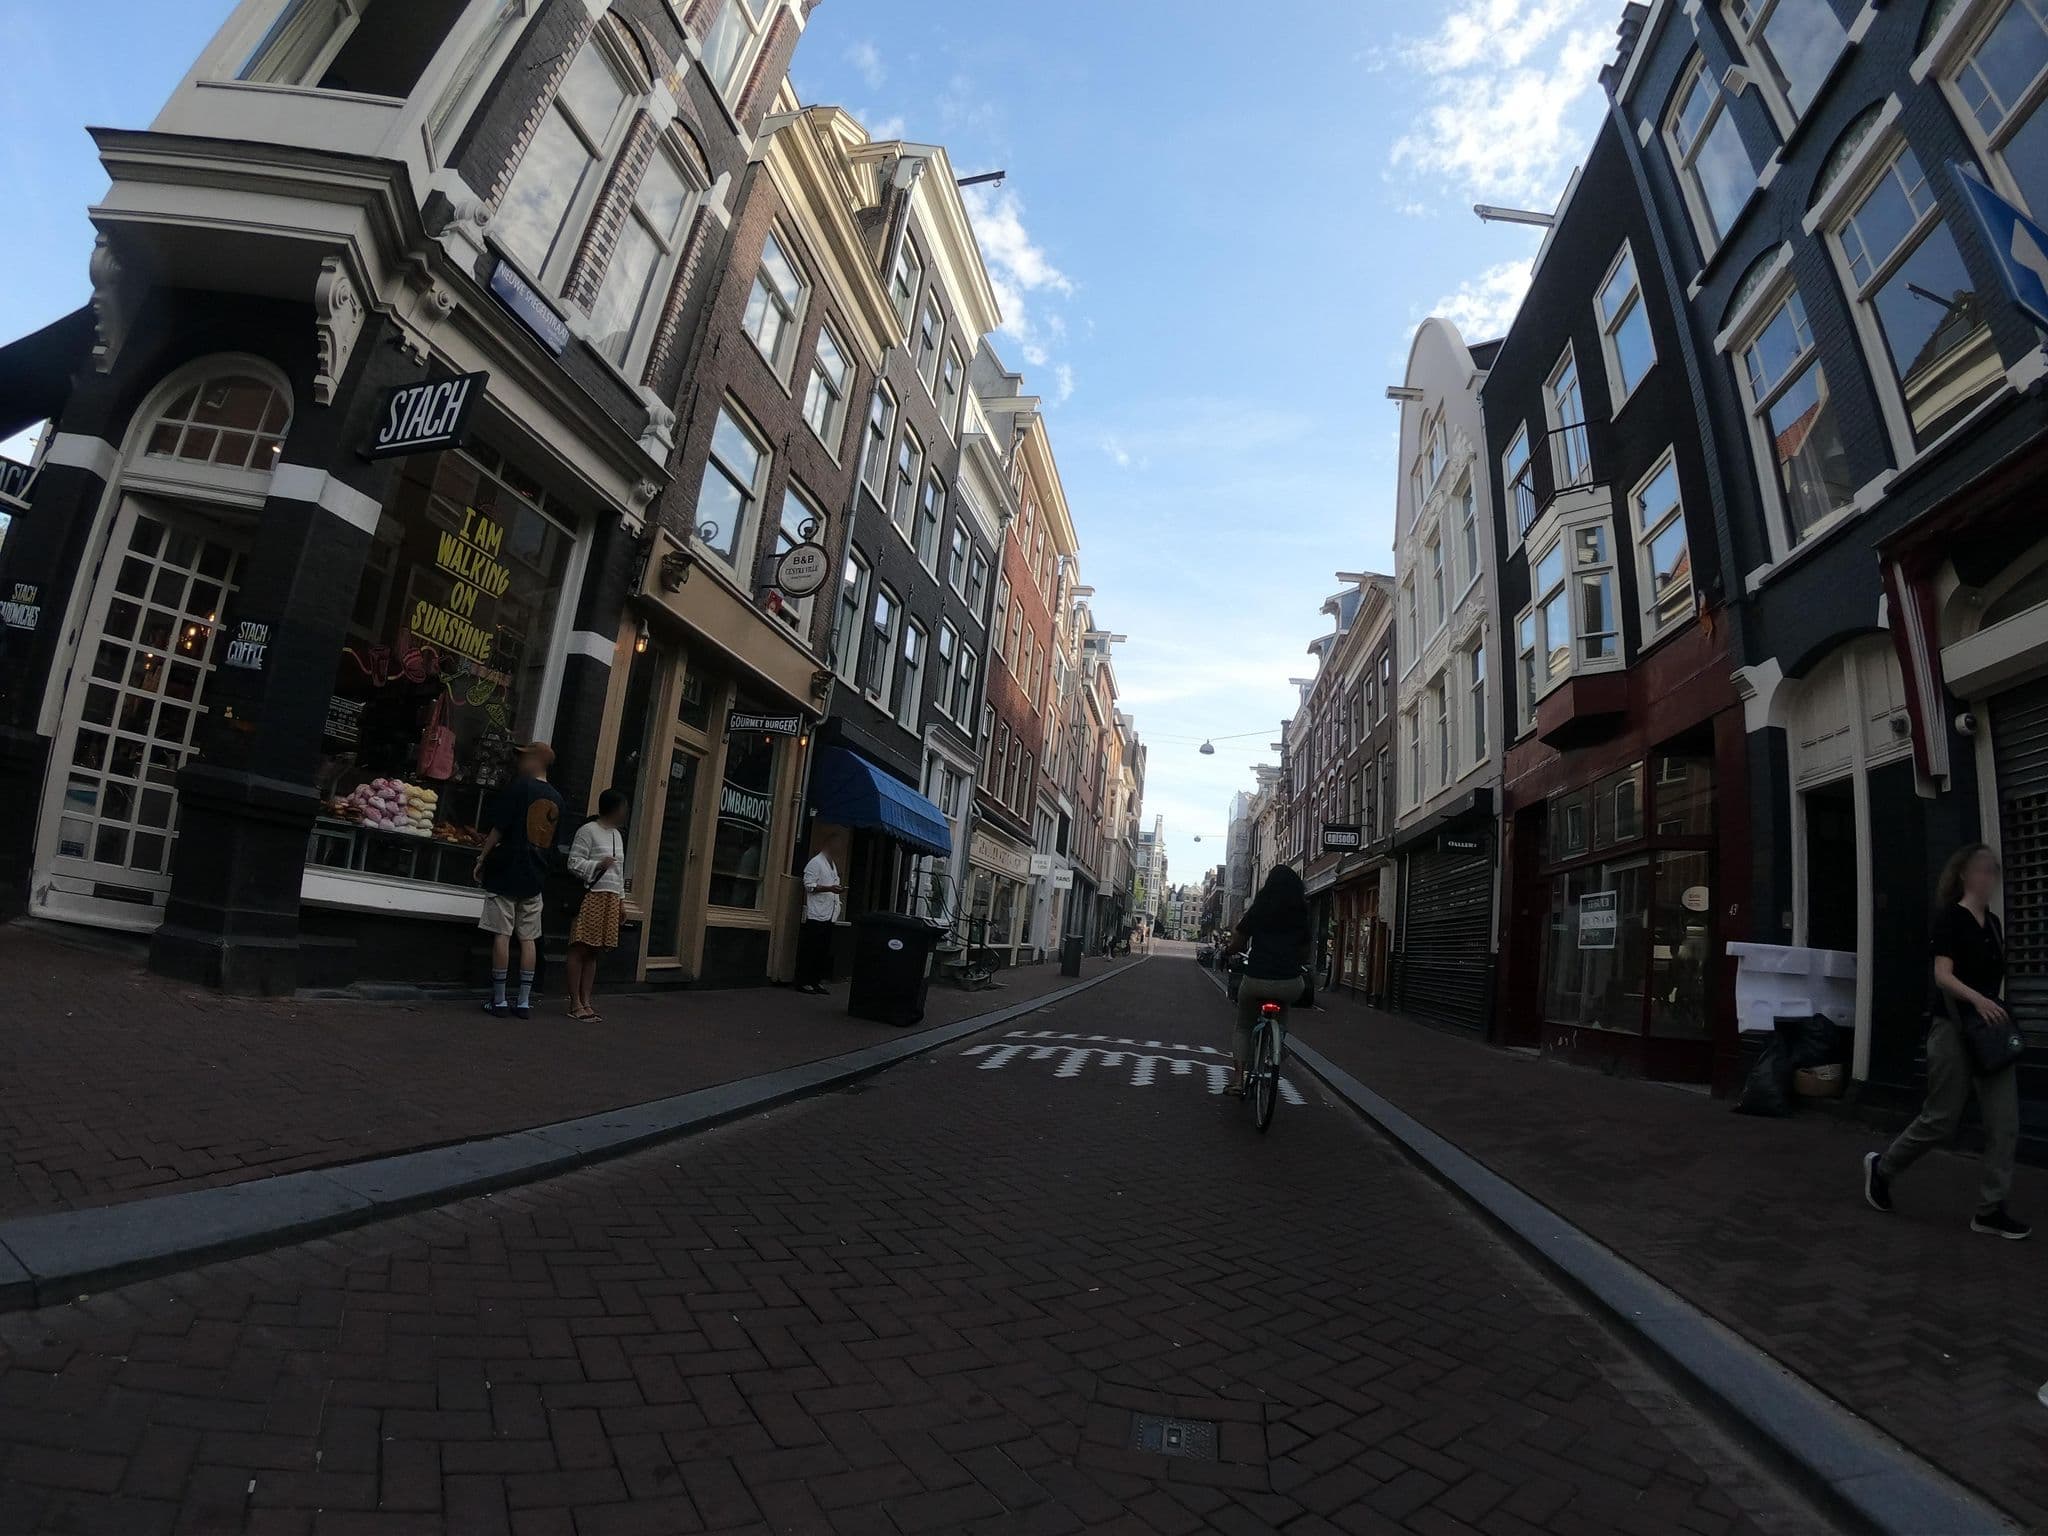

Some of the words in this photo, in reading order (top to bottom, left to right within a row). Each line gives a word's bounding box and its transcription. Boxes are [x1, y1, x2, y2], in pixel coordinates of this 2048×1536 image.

[380, 379, 470, 443] STACH
[459, 505, 477, 540] I
[475, 516, 504, 557] AM
[437, 530, 510, 596] WALKING
[793, 555, 814, 565] B&B
[12, 582, 38, 603] STACH
[451, 581, 479, 617] ON
[238, 621, 269, 642] STACH
[411, 600, 493, 660] SUNSHINE
[227, 641, 267, 664] COFFEE
[730, 715, 764, 729] GOURMET
[765, 719, 798, 733] BURGERS
[720, 786, 772, 825] OMBARDO'S
[1327, 831, 1356, 844] episode
